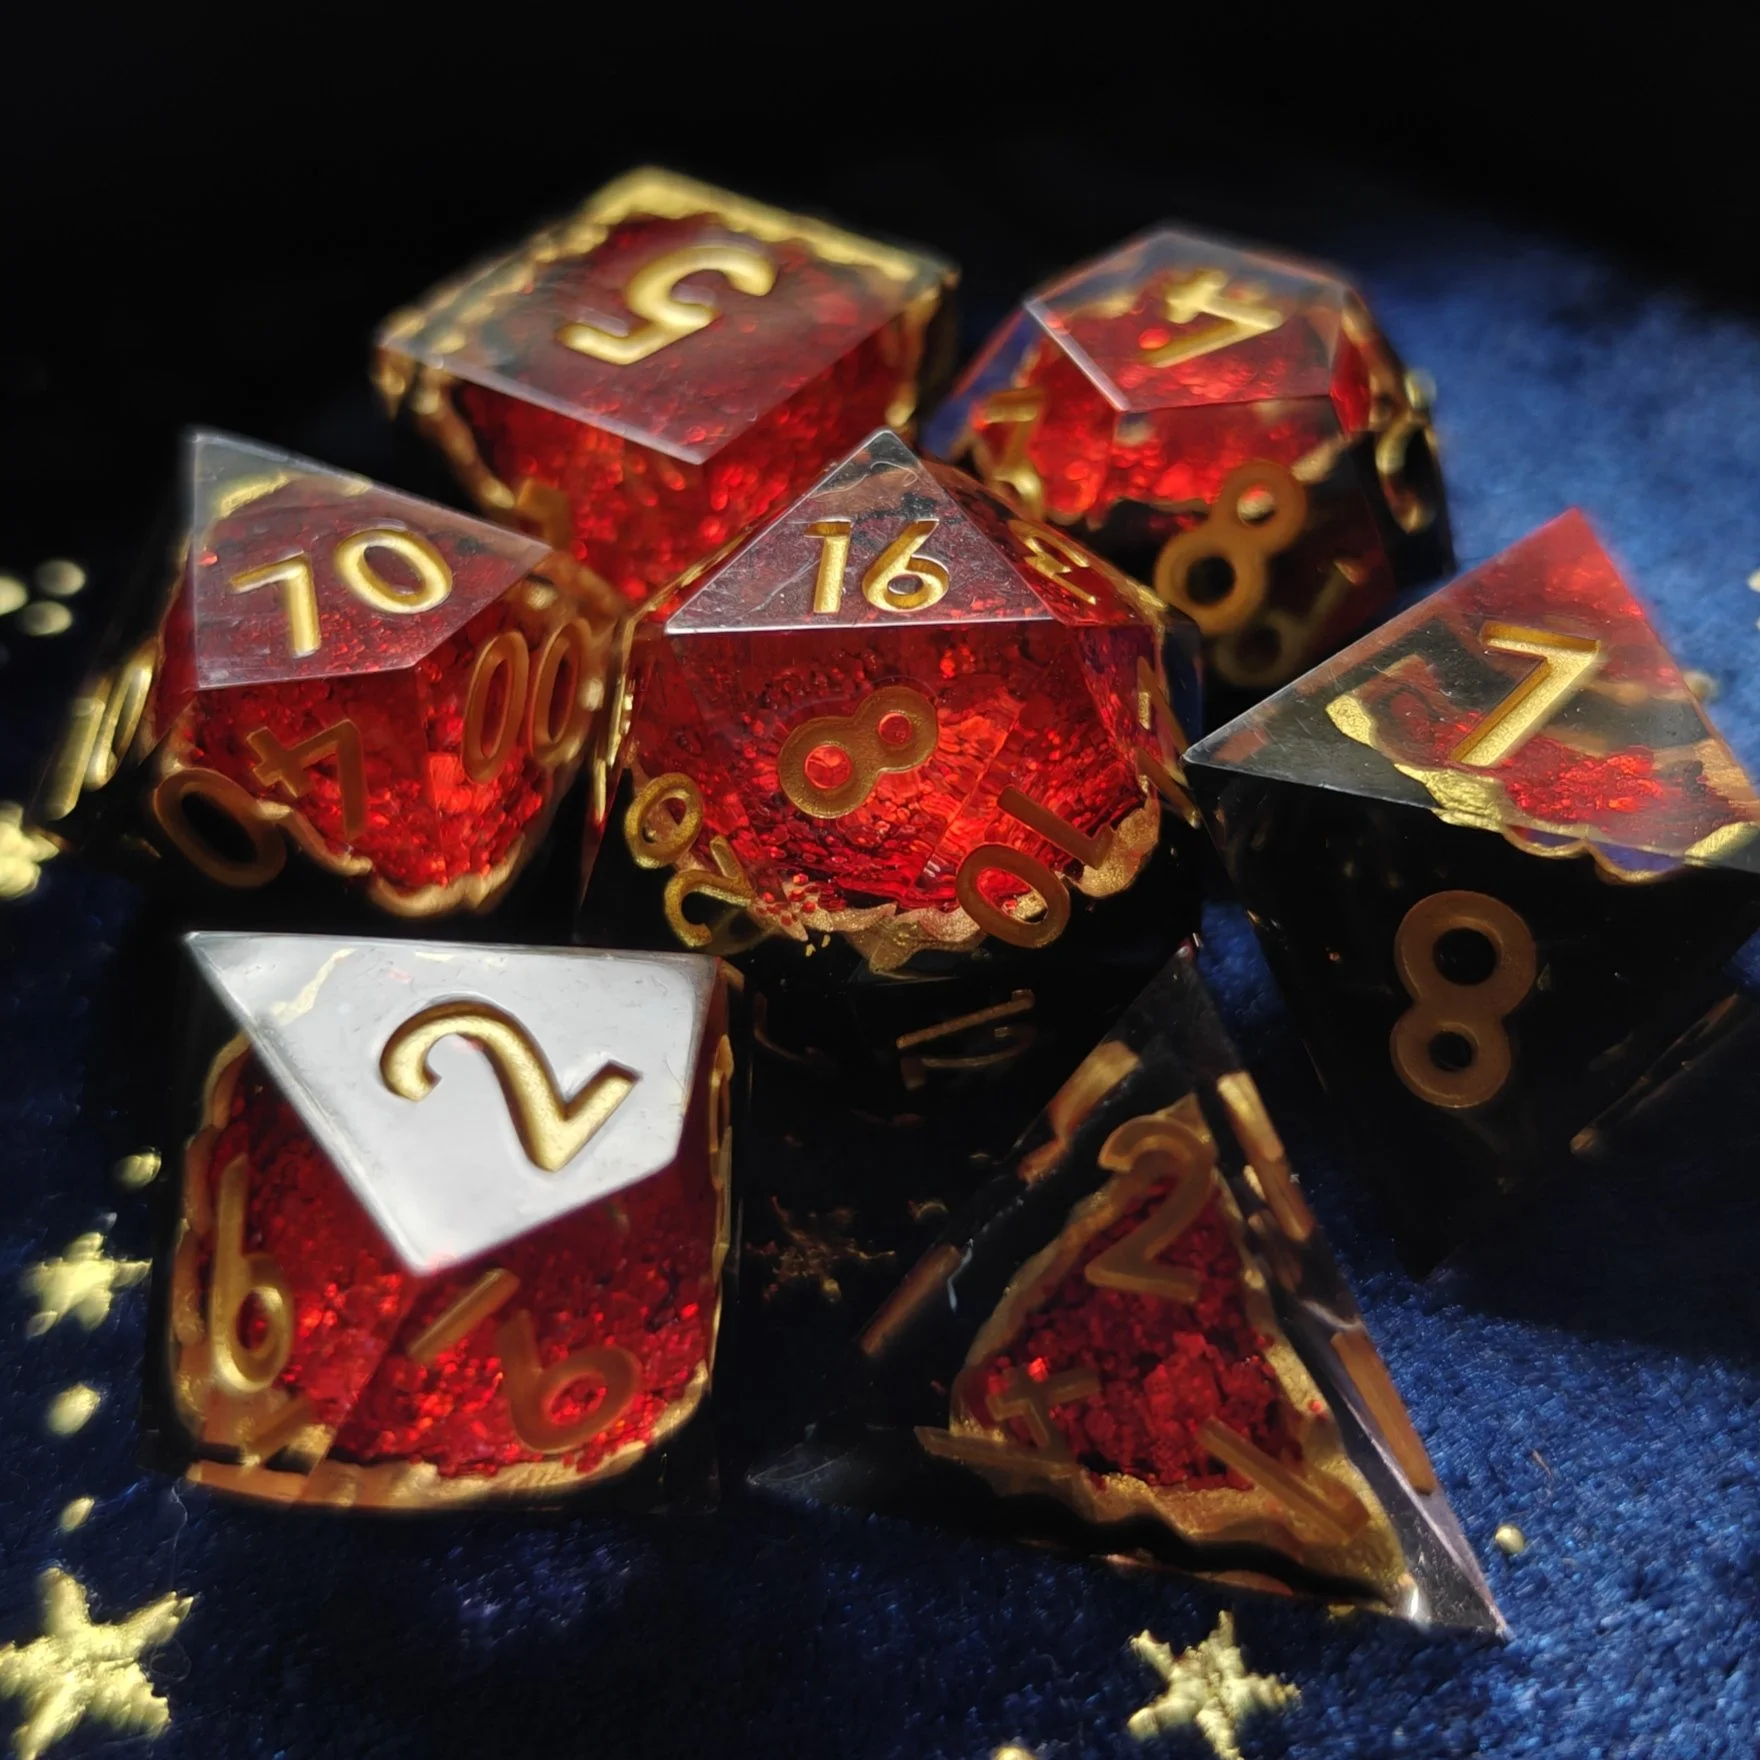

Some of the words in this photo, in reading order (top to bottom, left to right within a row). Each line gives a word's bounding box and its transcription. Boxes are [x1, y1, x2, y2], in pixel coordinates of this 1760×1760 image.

[556, 244, 776, 366] 5
[229, 526, 453, 659] 70
[803, 518, 950, 614] 16
[1154, 459, 1309, 637] 8
[778, 685, 939, 819] 8
[1449, 618, 1601, 768] 7
[957, 785, 1116, 948] 10
[1389, 889, 1538, 1109] 8
[379, 997, 641, 1173] 2
[1085, 1114, 1214, 1300] 2
